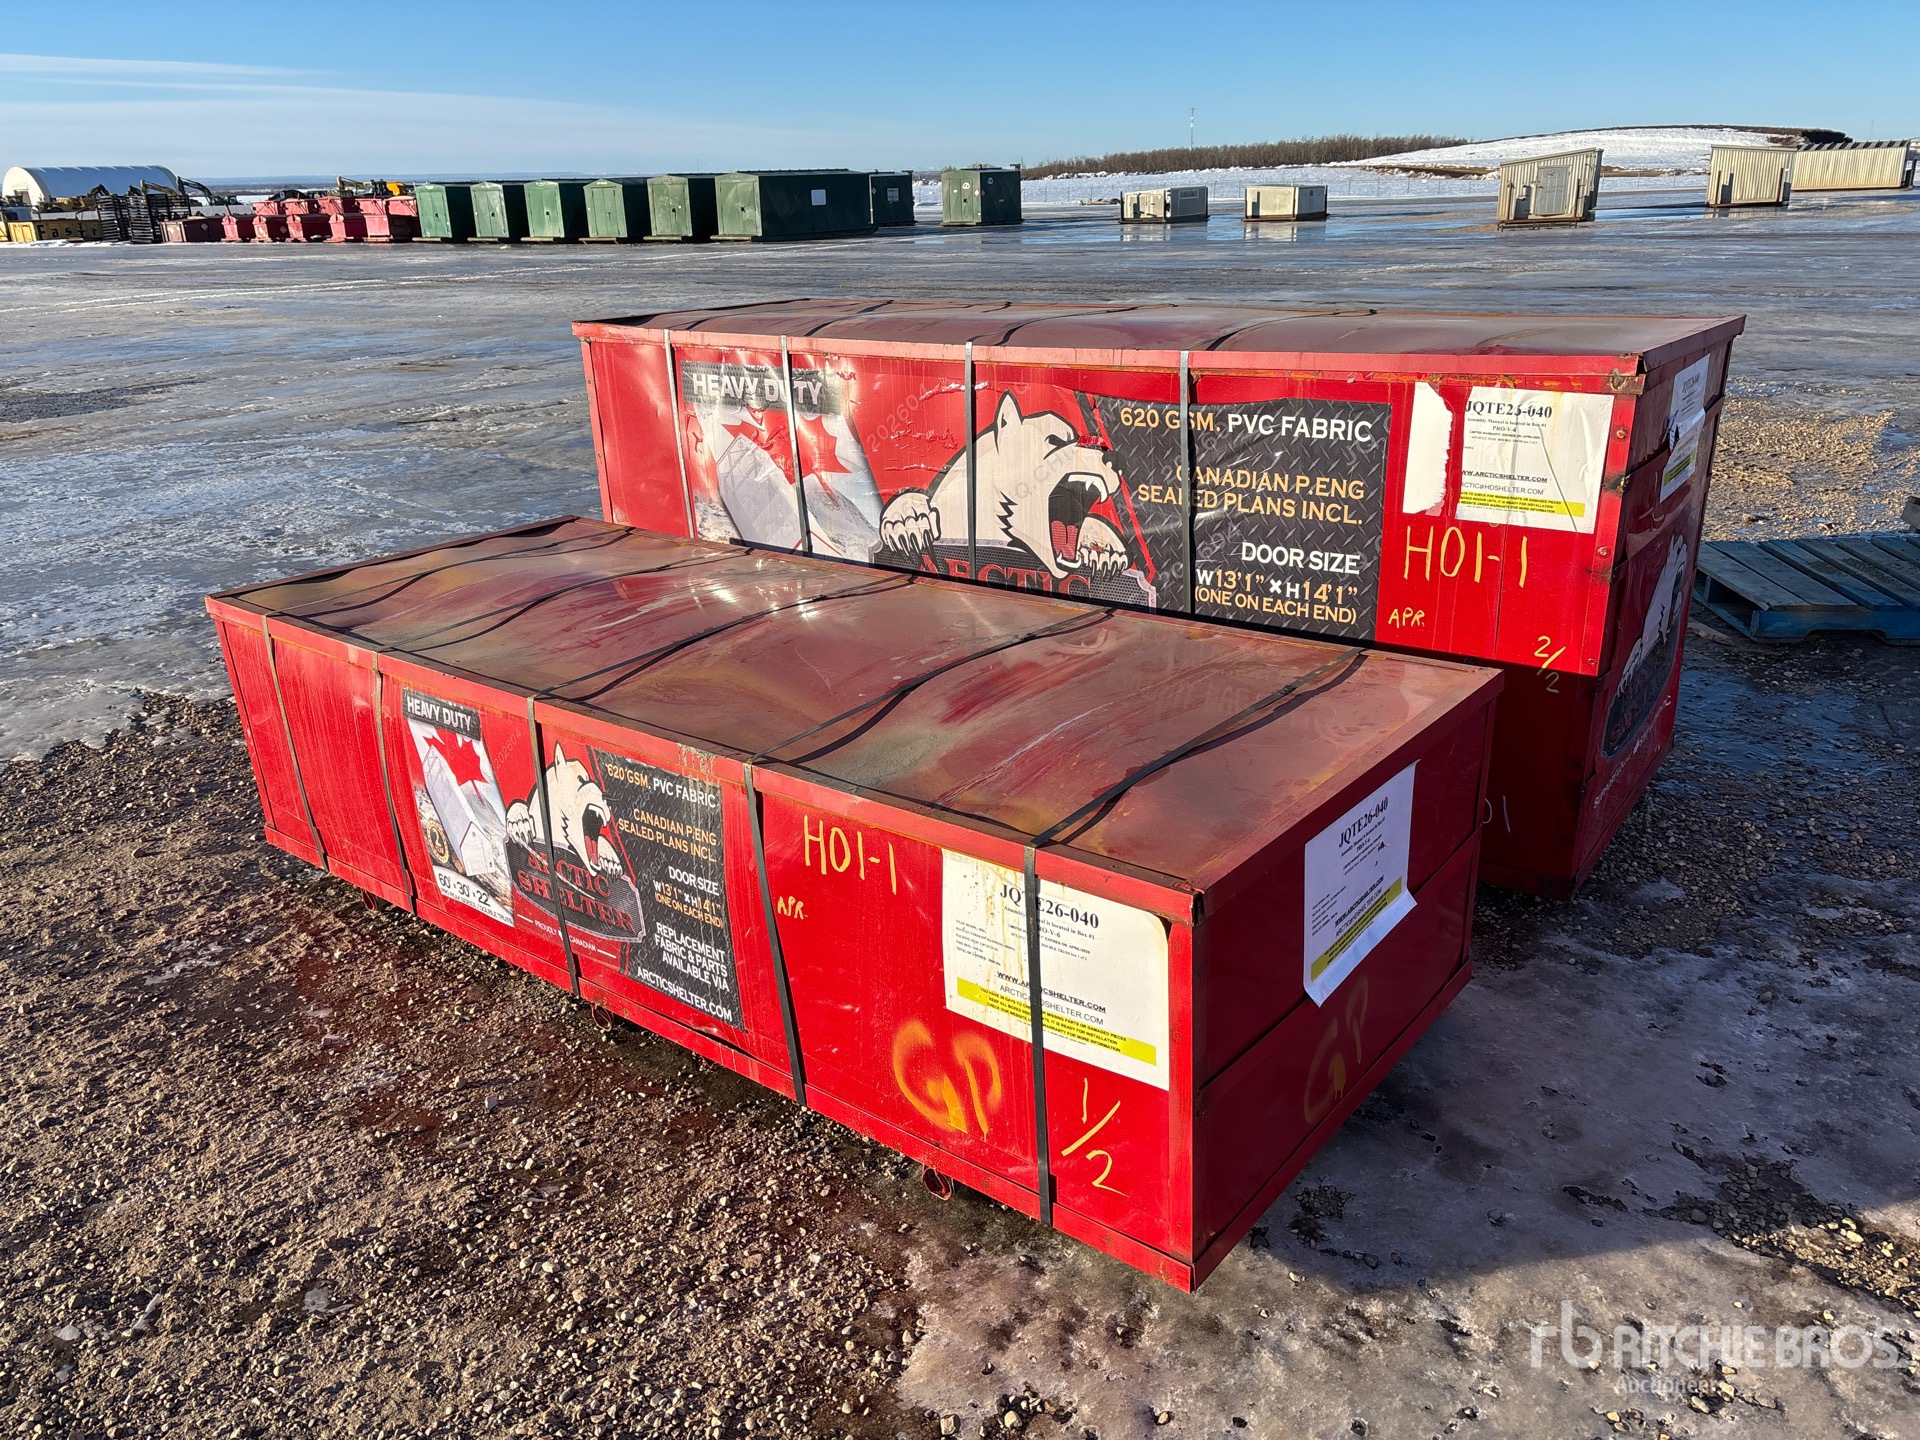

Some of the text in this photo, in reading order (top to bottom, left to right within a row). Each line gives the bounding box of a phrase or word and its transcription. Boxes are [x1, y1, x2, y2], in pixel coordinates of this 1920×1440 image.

[692, 373, 759, 398] HEAVY
[1120, 408, 1159, 427] 620
[1227, 413, 1274, 435] PVC
[1281, 416, 1373, 442] FABRIC
[1295, 475, 1365, 500] P.ENG
[1224, 494, 1295, 518] PLANS
[1301, 501, 1363, 525] INCL.
[1241, 542, 1304, 568] DOOR
[1309, 550, 1361, 575] SIZE
[1195, 587, 1356, 625] (ONE ON EACH END)
[407, 696, 472, 732] HEAVY DUTY
[607, 764, 624, 781] 620
[653, 778, 673, 796] PVC
[676, 785, 716, 808] FABRIC
[618, 818, 654, 841] SEALED
[656, 831, 688, 853] PLANS
[633, 808, 684, 836] CANADIAN
[1338, 796, 1389, 848] JQTE26-040
[668, 866, 696, 885] DOOR
[698, 876, 720, 896] SIZE
[672, 900, 683, 913] ON
[683, 905, 704, 922] EACH
[1000, 884, 1099, 929] JQE26-040
[654, 934, 686, 961] FABRIC
[688, 951, 694, 962] &
[695, 956, 728, 978] PARTS
[656, 922, 725, 963] REPLACEMENT
[662, 951, 711, 985] AVAILABLE
[711, 974, 730, 992] VIA
[637, 967, 732, 1022] ARCTICSHELTER.COM
